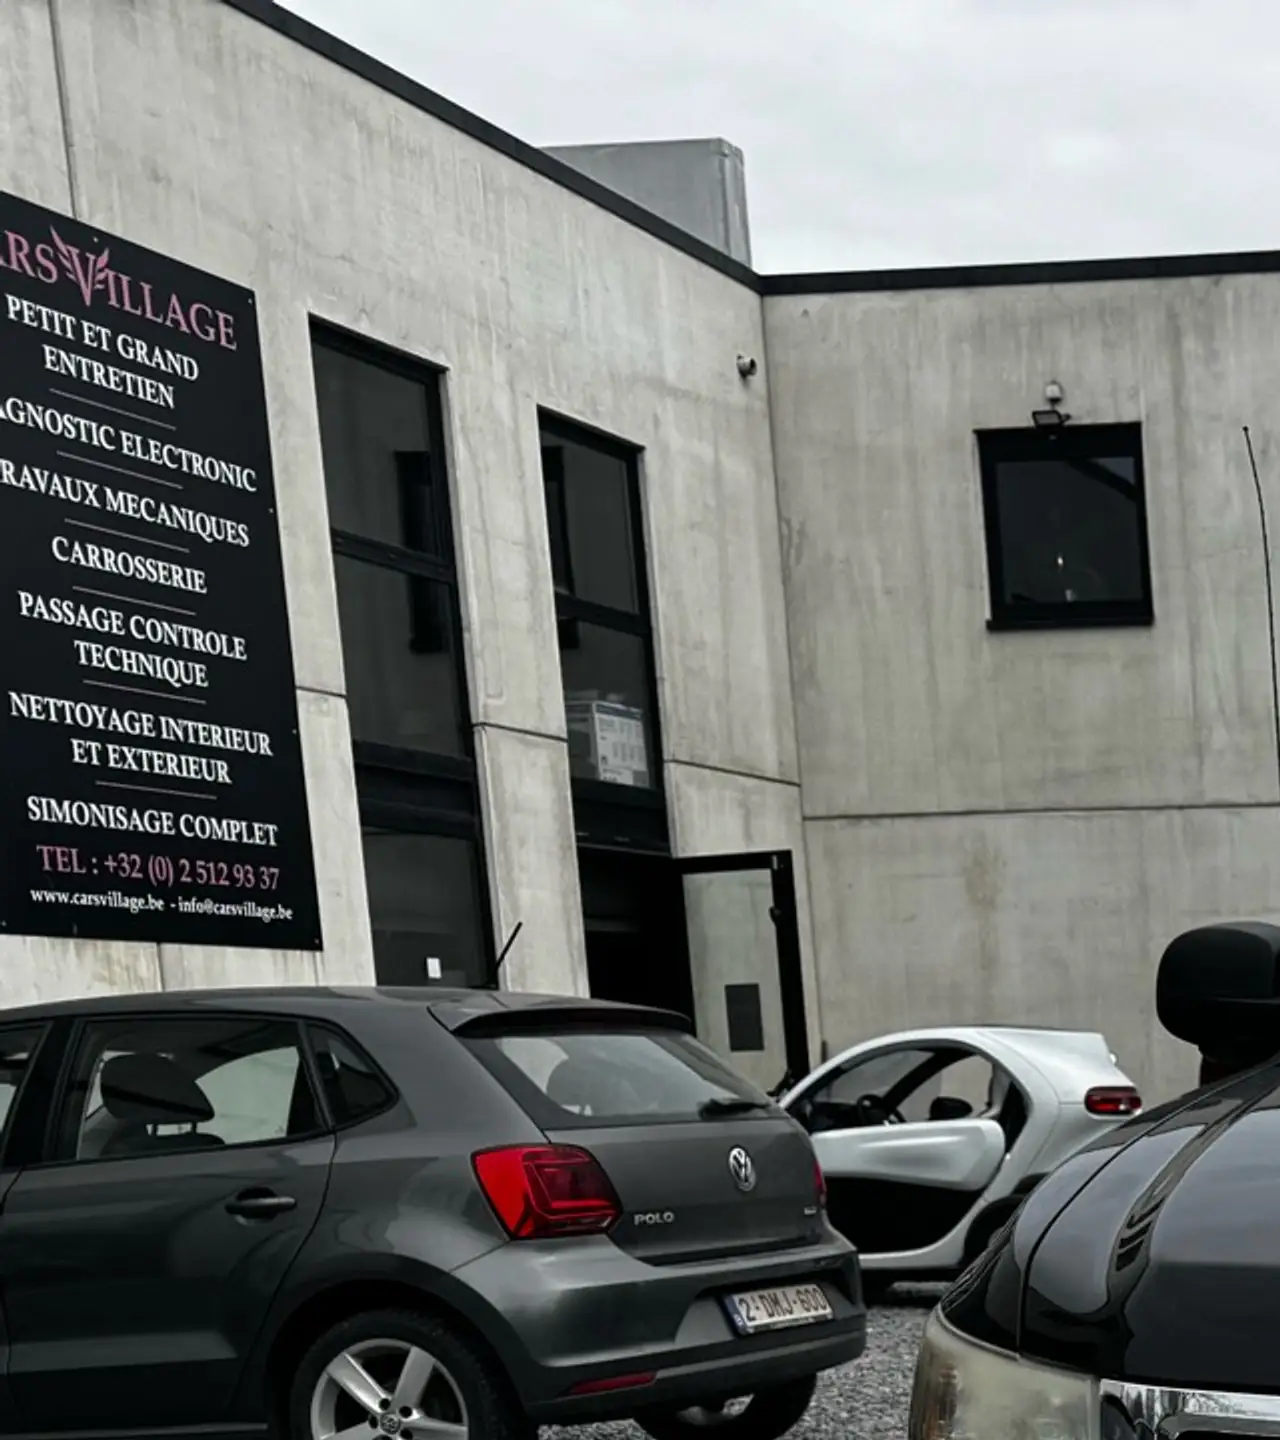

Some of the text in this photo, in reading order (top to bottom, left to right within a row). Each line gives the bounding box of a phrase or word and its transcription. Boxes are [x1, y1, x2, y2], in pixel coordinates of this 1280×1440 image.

[0, 230, 237, 351] RSVILLAGE
[5, 293, 200, 381] PETIT ET GRAND
[41, 343, 176, 410] ENTRETIEN
[118, 429, 257, 493] ELECTRONIC
[0, 457, 250, 548] RAVAUX MECANIQUES
[51, 535, 208, 594] CARROSSERIE
[18, 590, 248, 661] PASSAGE CONTROLE
[74, 639, 209, 689] TECHNIQUE
[8, 690, 274, 757] NETTOYAGE INTERIEUR
[70, 738, 233, 784] ET EXTERIEUR
[27, 795, 278, 847] SIMONISAGE COMPLET
[36, 845, 87, 875] TEL
[103, 855, 143, 881] +32
[148, 855, 174, 887] (0)
[180, 858, 192, 883] 2
[196, 860, 230, 886] 512
[233, 864, 255, 889] 93
[259, 866, 280, 890] 37
[30, 888, 165, 916] www.carsvillage.be
[177, 895, 293, 923] info@carsvillage.be
[634, 1211, 675, 1225] POLO
